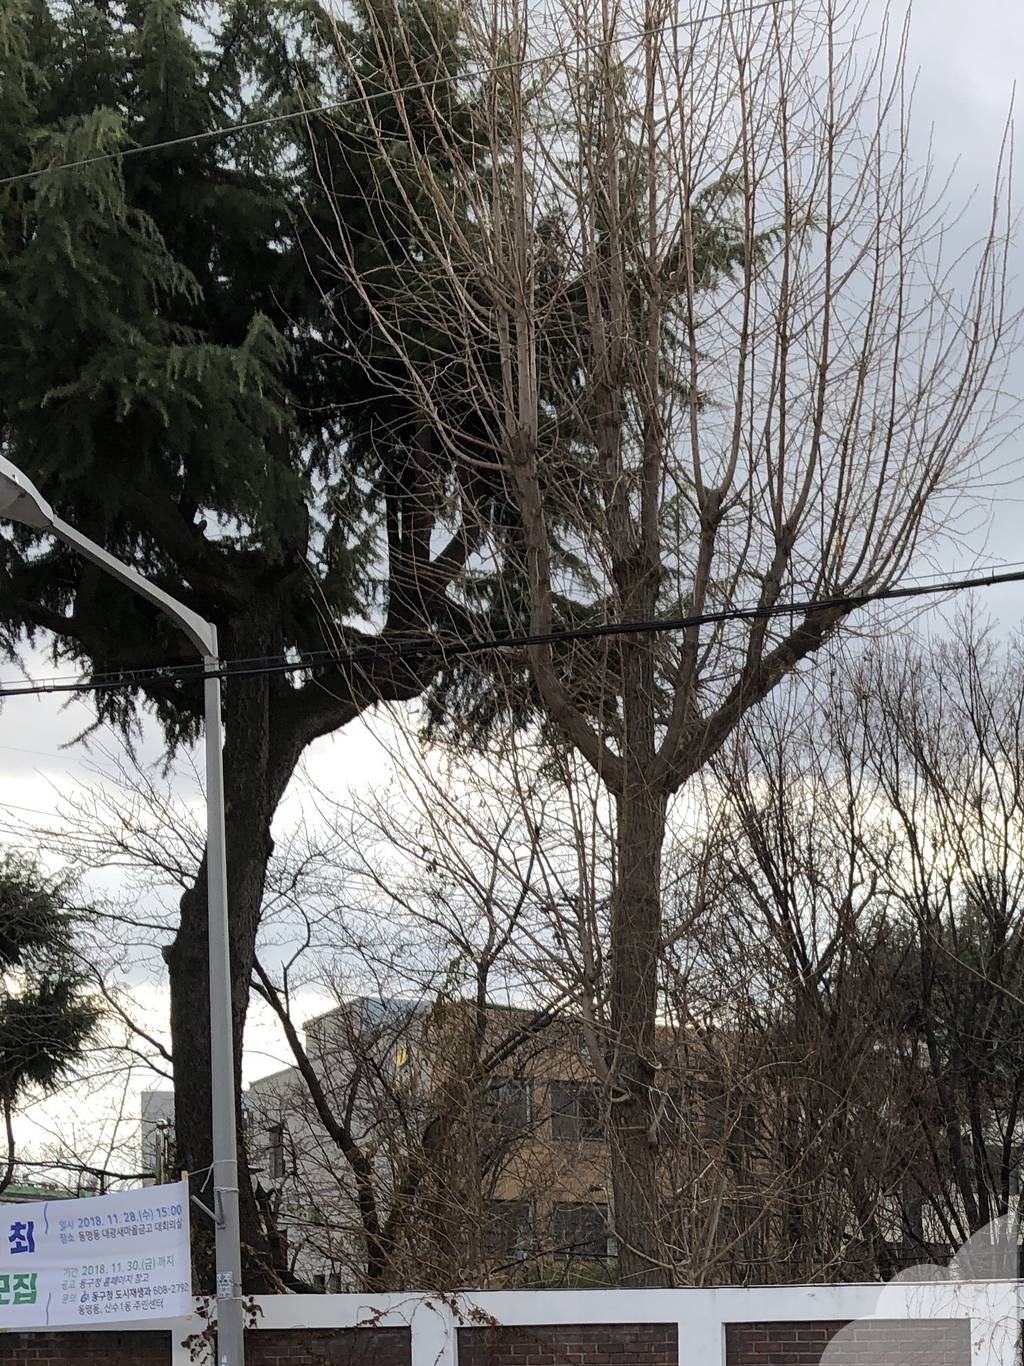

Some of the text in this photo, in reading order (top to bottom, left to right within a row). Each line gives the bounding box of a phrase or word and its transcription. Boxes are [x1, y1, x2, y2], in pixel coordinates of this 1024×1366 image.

[78, 1215, 104, 1228] 2018.
[156, 1205, 182, 1218] 15:00
[82, 1263, 108, 1276] 2018.
